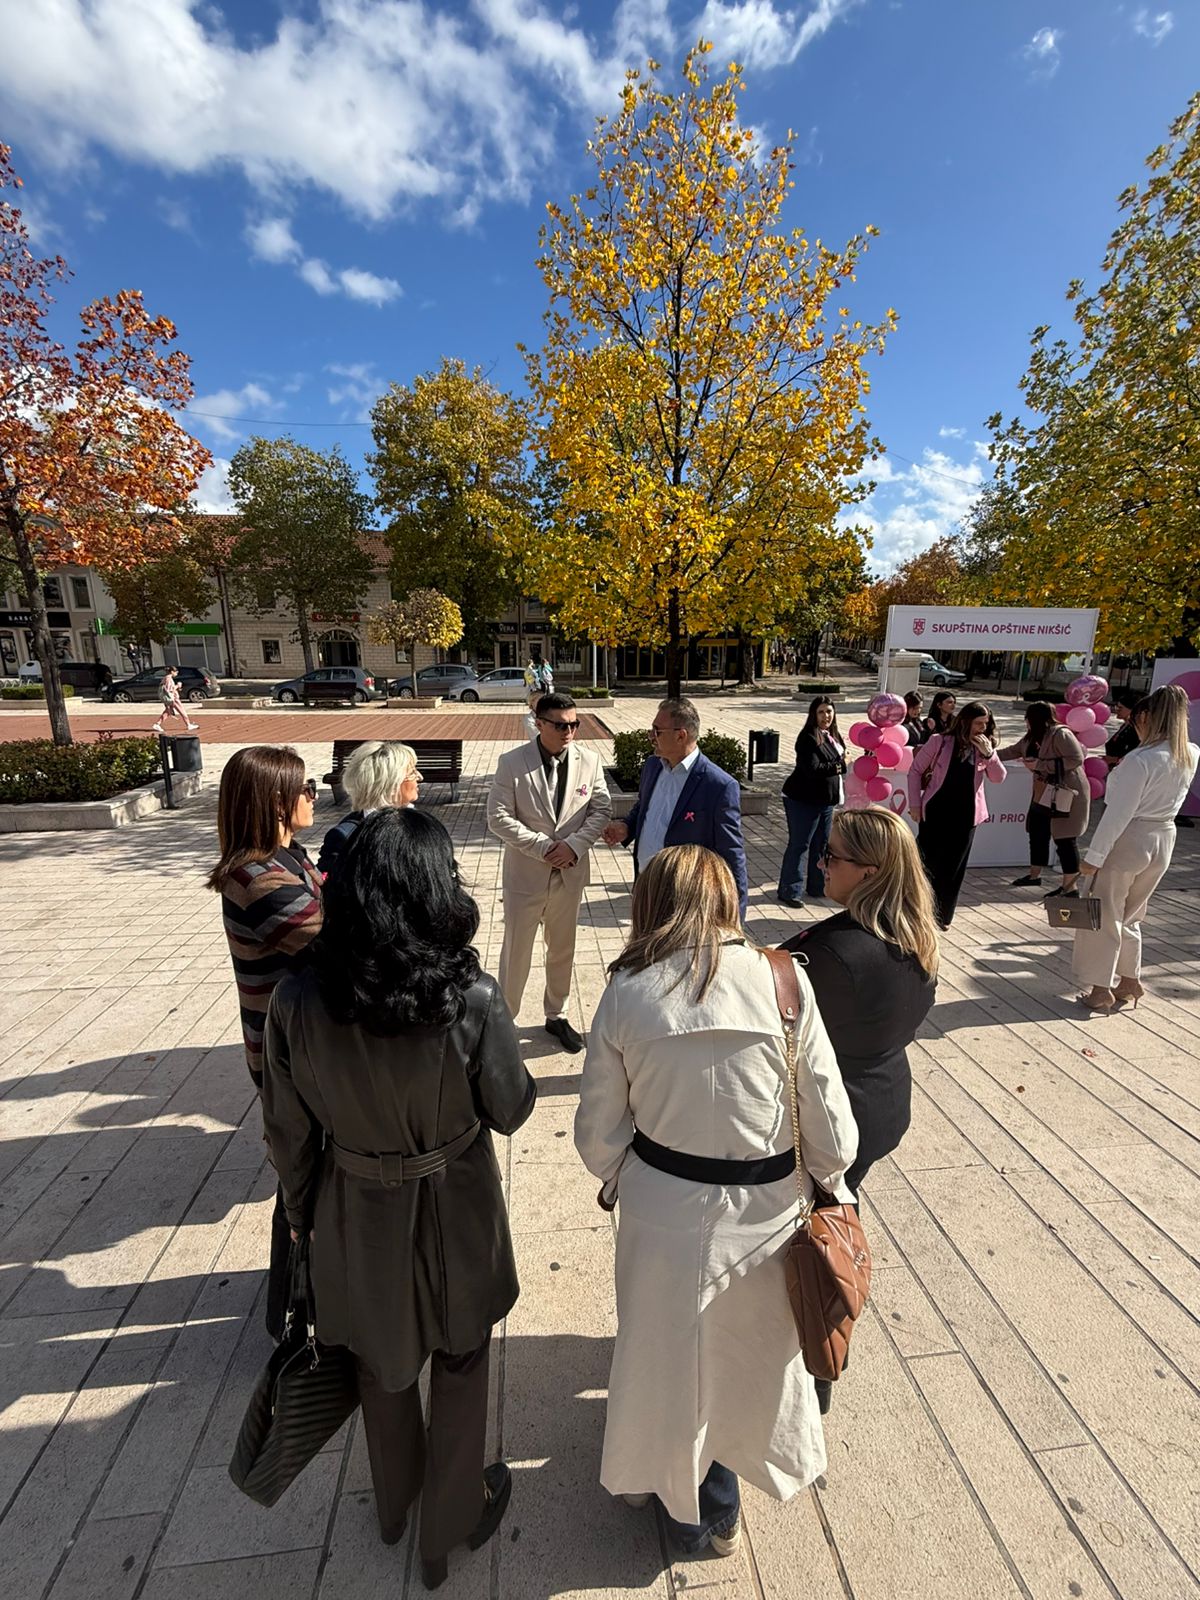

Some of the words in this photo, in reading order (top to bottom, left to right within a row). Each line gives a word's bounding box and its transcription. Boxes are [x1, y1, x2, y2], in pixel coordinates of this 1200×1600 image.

[932, 622, 990, 634] SKUPŠTINA
[991, 623, 1036, 635] OPŠTINE
[1037, 623, 1072, 635] NIKŠIĆ
[982, 813, 995, 823] BI
